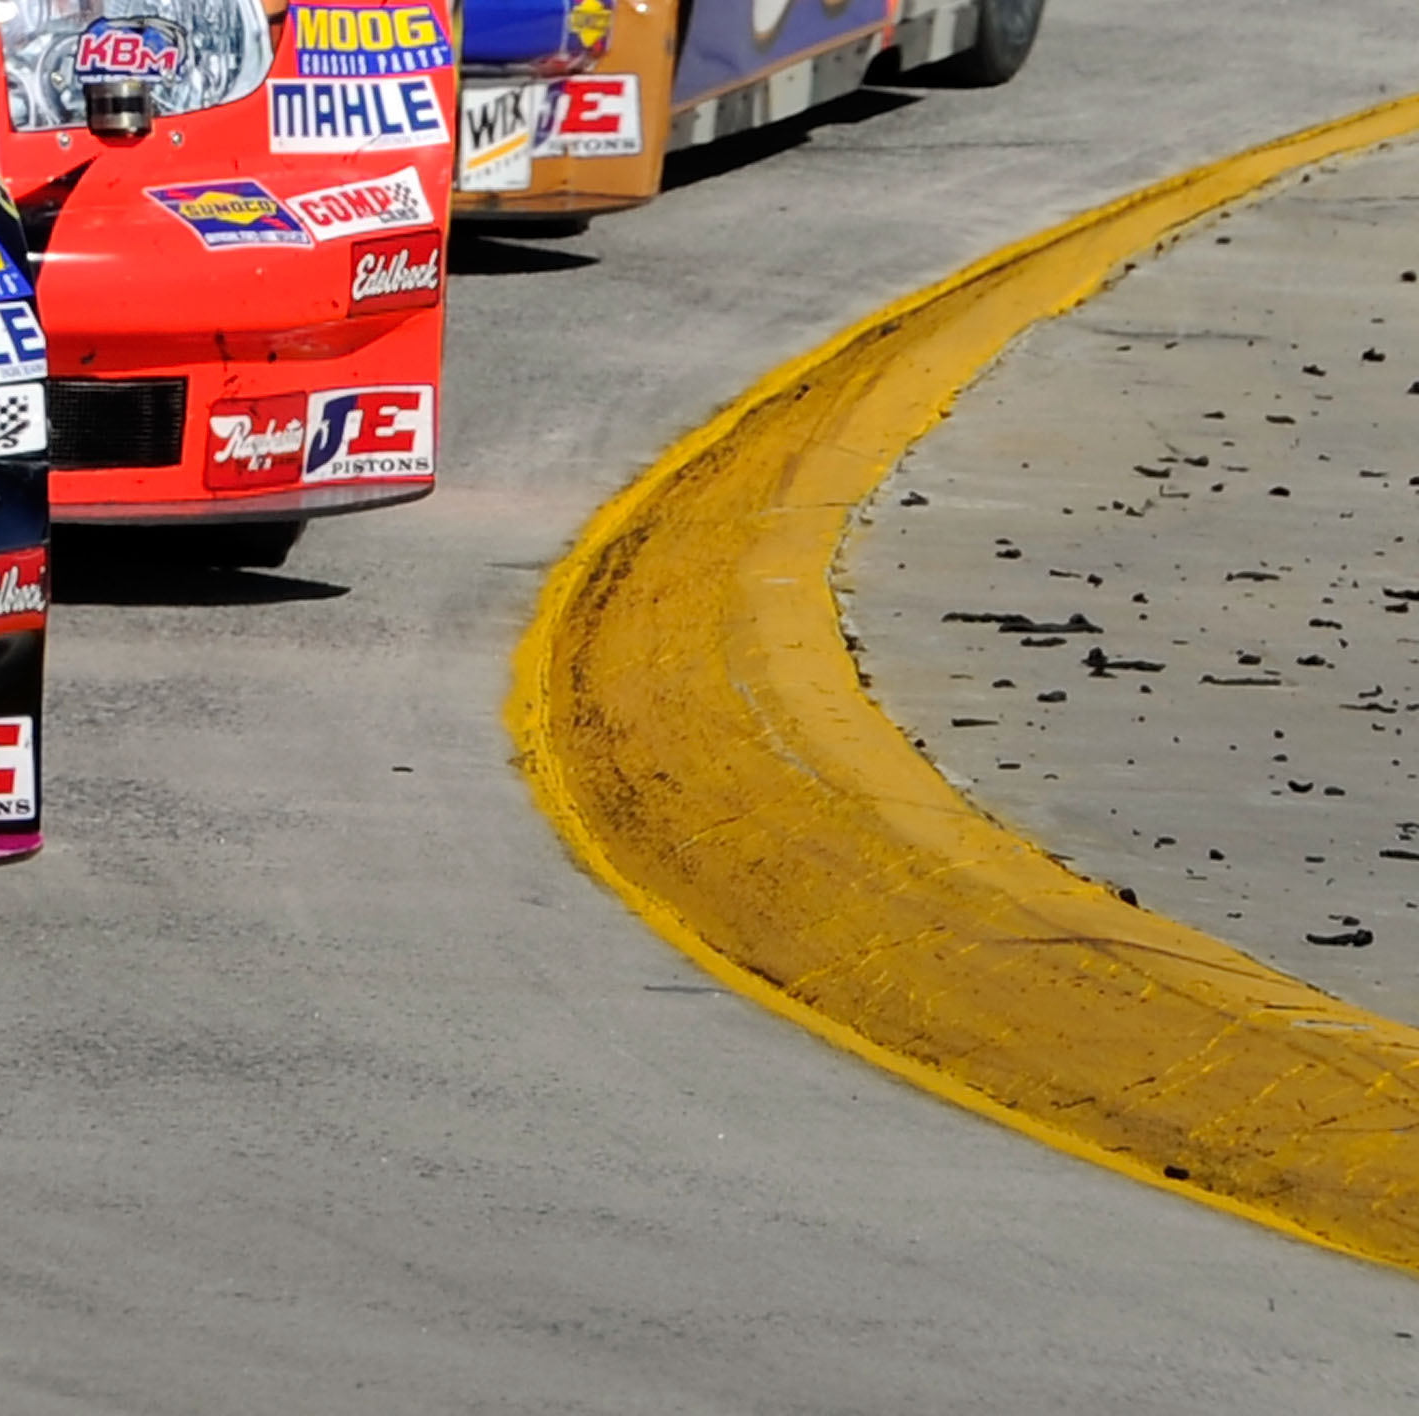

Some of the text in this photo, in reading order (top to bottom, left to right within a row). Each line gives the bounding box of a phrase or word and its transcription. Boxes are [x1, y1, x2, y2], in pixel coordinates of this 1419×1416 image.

[297, 7, 436, 51] MOOG
[75, 31, 179, 73] KBM
[377, 47, 444, 74] PARTS
[272, 81, 440, 137] MAHLE
[185, 199, 275, 217] SUNOCO
[300, 186, 393, 227] COMP
[307, 392, 421, 474] JE
[332, 457, 429, 475] PISTONS
